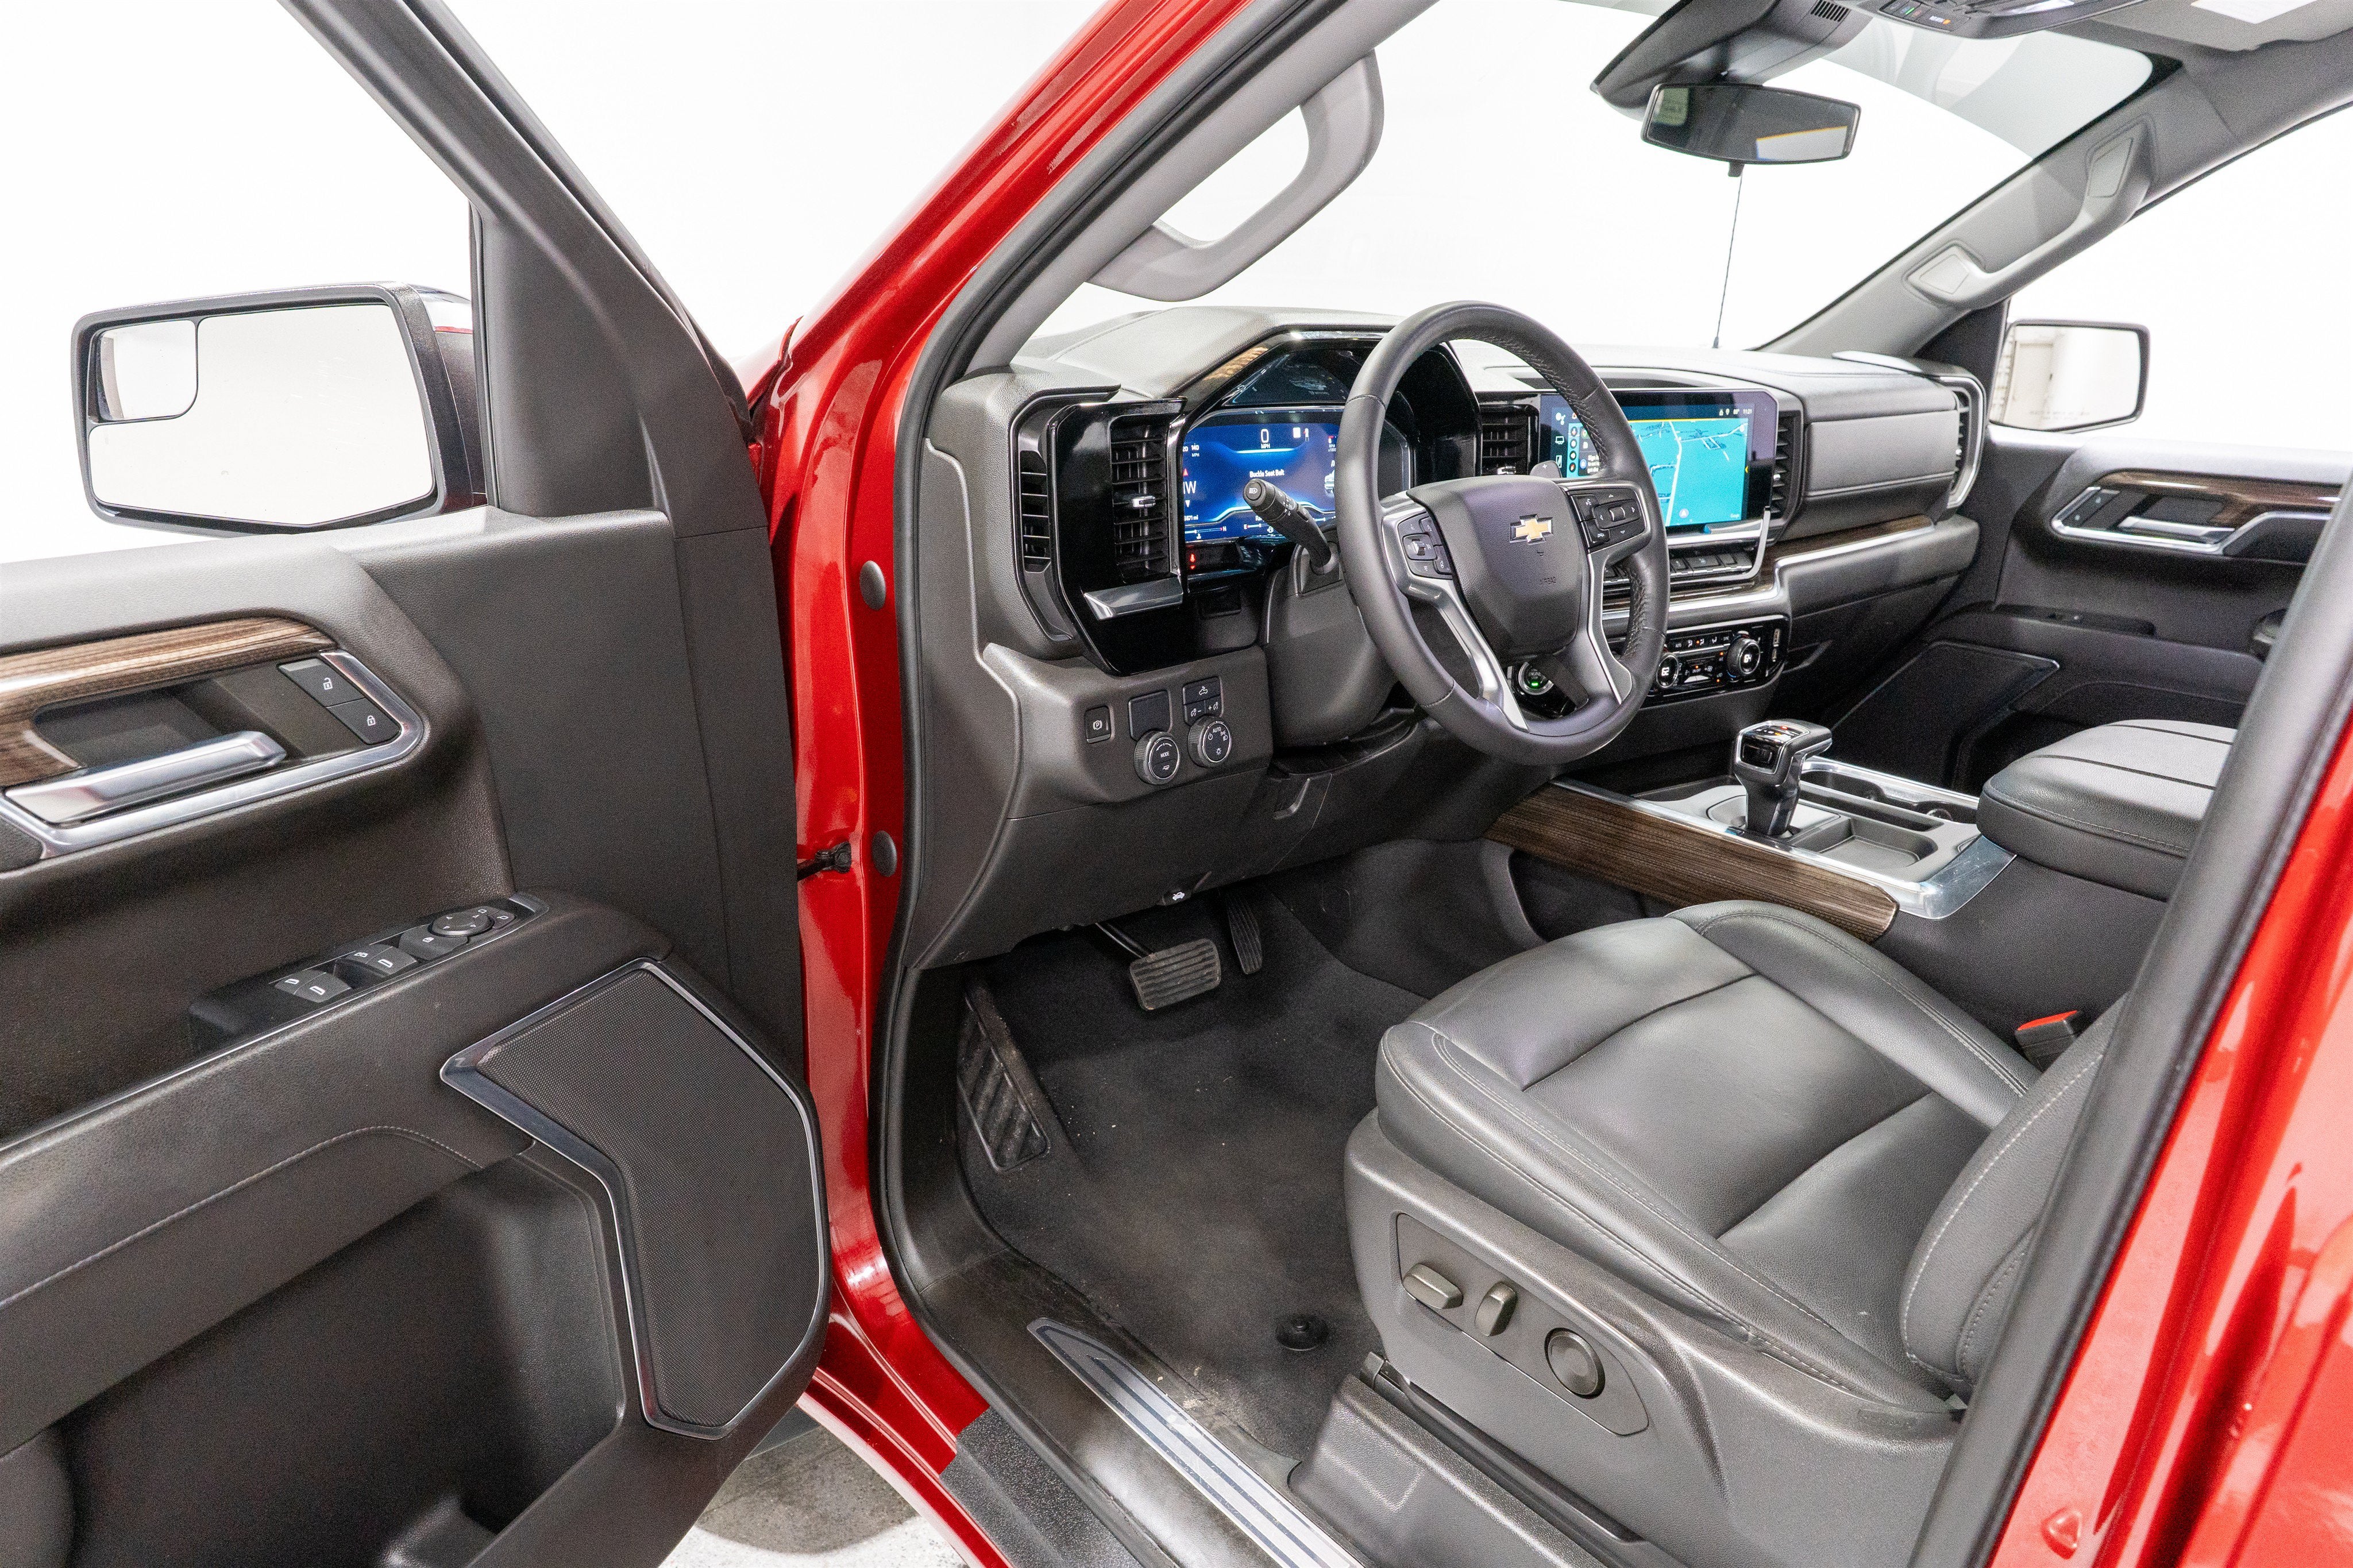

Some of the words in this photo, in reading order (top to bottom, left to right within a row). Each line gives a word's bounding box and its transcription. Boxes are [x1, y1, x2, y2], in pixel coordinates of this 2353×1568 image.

[1260, 428, 1270, 443] 0
[1249, 470, 1264, 478] Buckle
[1275, 468, 1284, 476] Belt
